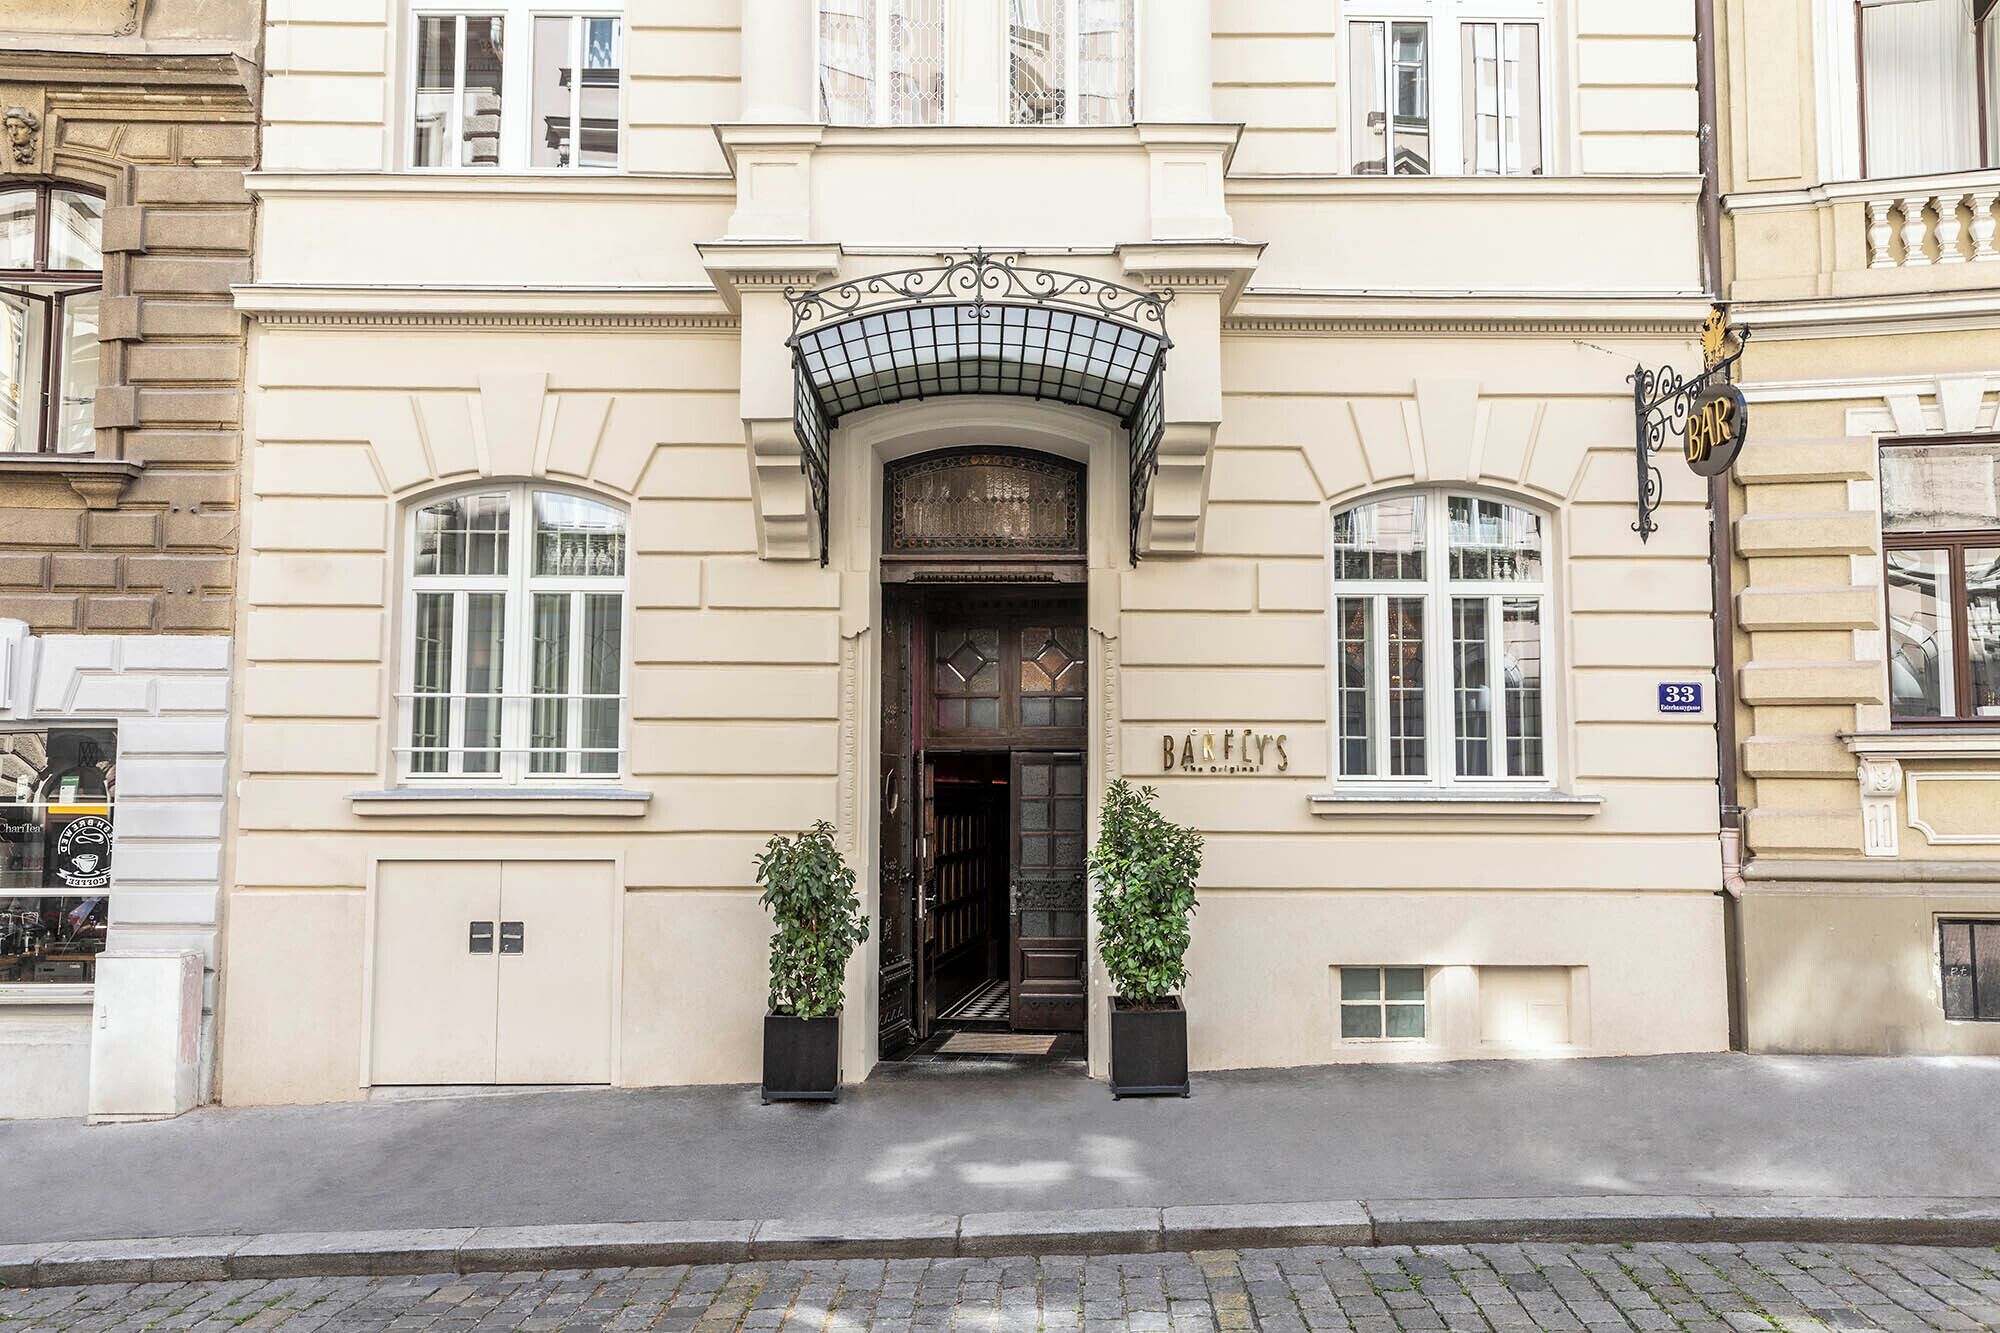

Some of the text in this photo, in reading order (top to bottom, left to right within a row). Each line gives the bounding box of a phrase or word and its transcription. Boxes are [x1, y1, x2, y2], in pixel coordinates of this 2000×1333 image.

[1687, 396, 1732, 463] BAR
[1666, 686, 1695, 703] 33
[1163, 734, 1288, 771] BARFLY'S
[1183, 765, 1260, 774] The Original
